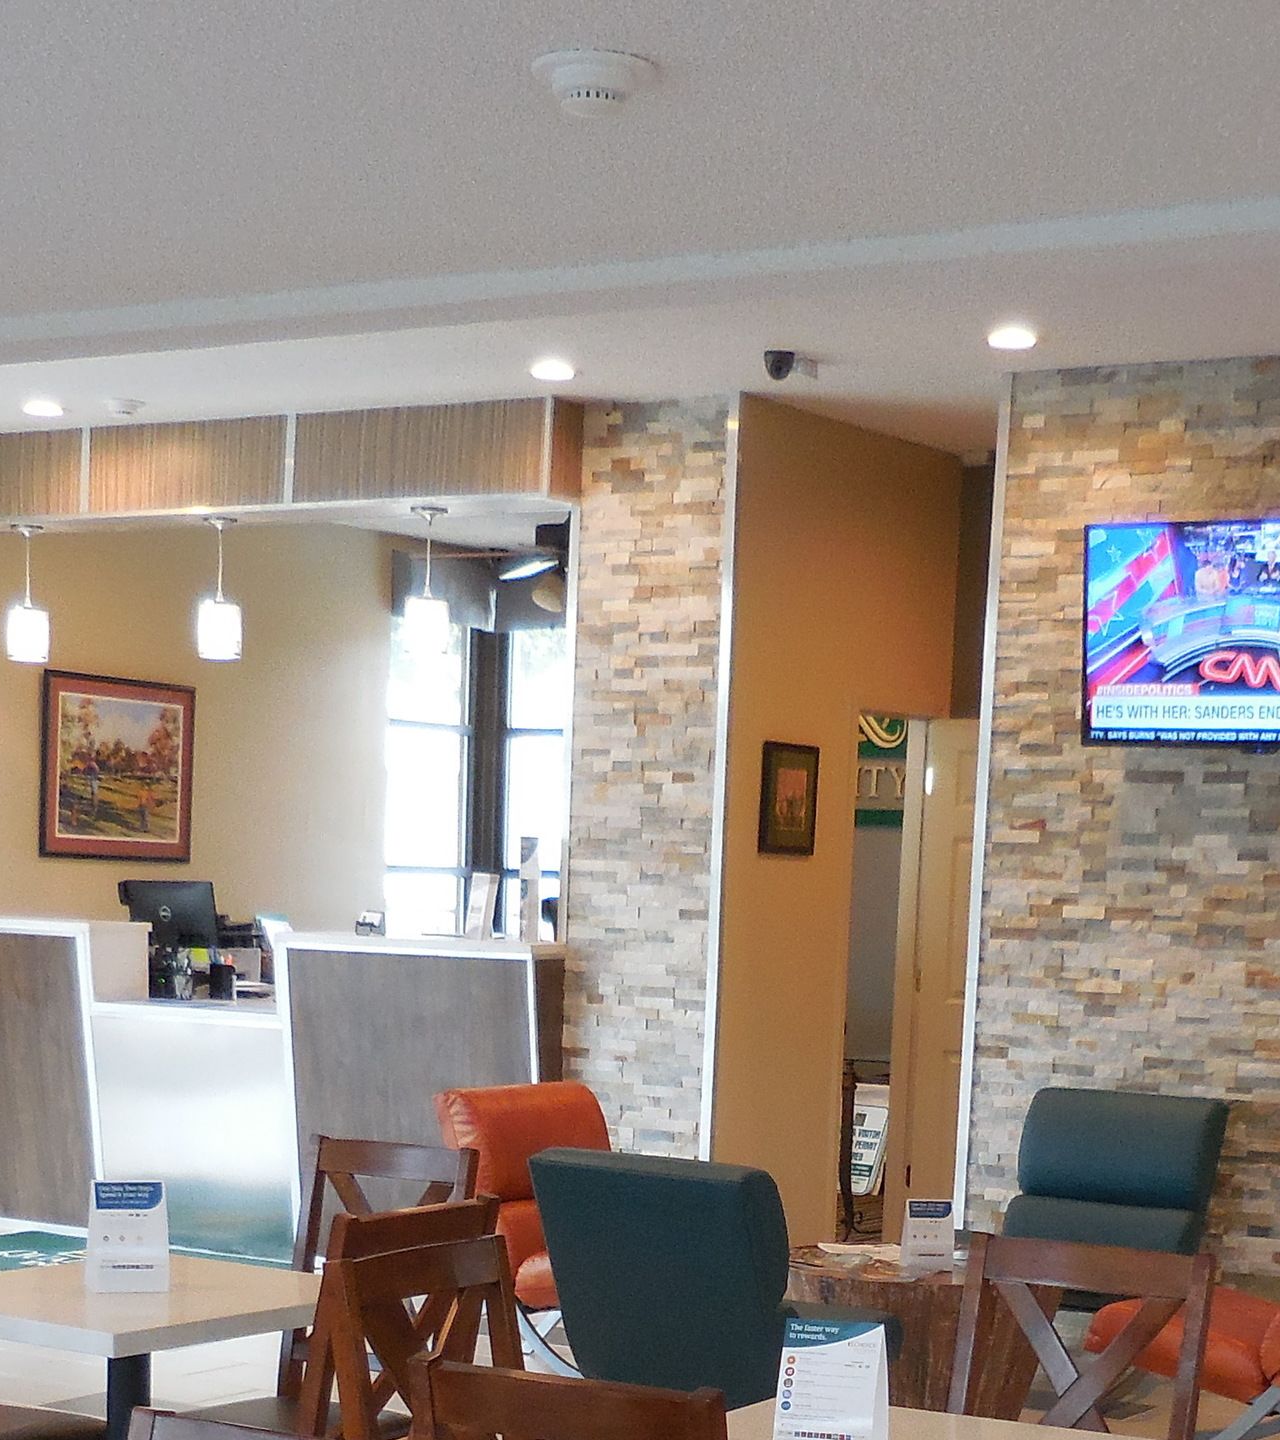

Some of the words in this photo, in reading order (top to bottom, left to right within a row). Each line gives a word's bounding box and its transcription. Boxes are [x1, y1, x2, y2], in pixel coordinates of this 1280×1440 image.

[1096, 705, 1123, 719] HE'S
[1127, 705, 1157, 719] WITH
[1162, 705, 1191, 719] HER:
[1194, 705, 1254, 720] SANDERS
